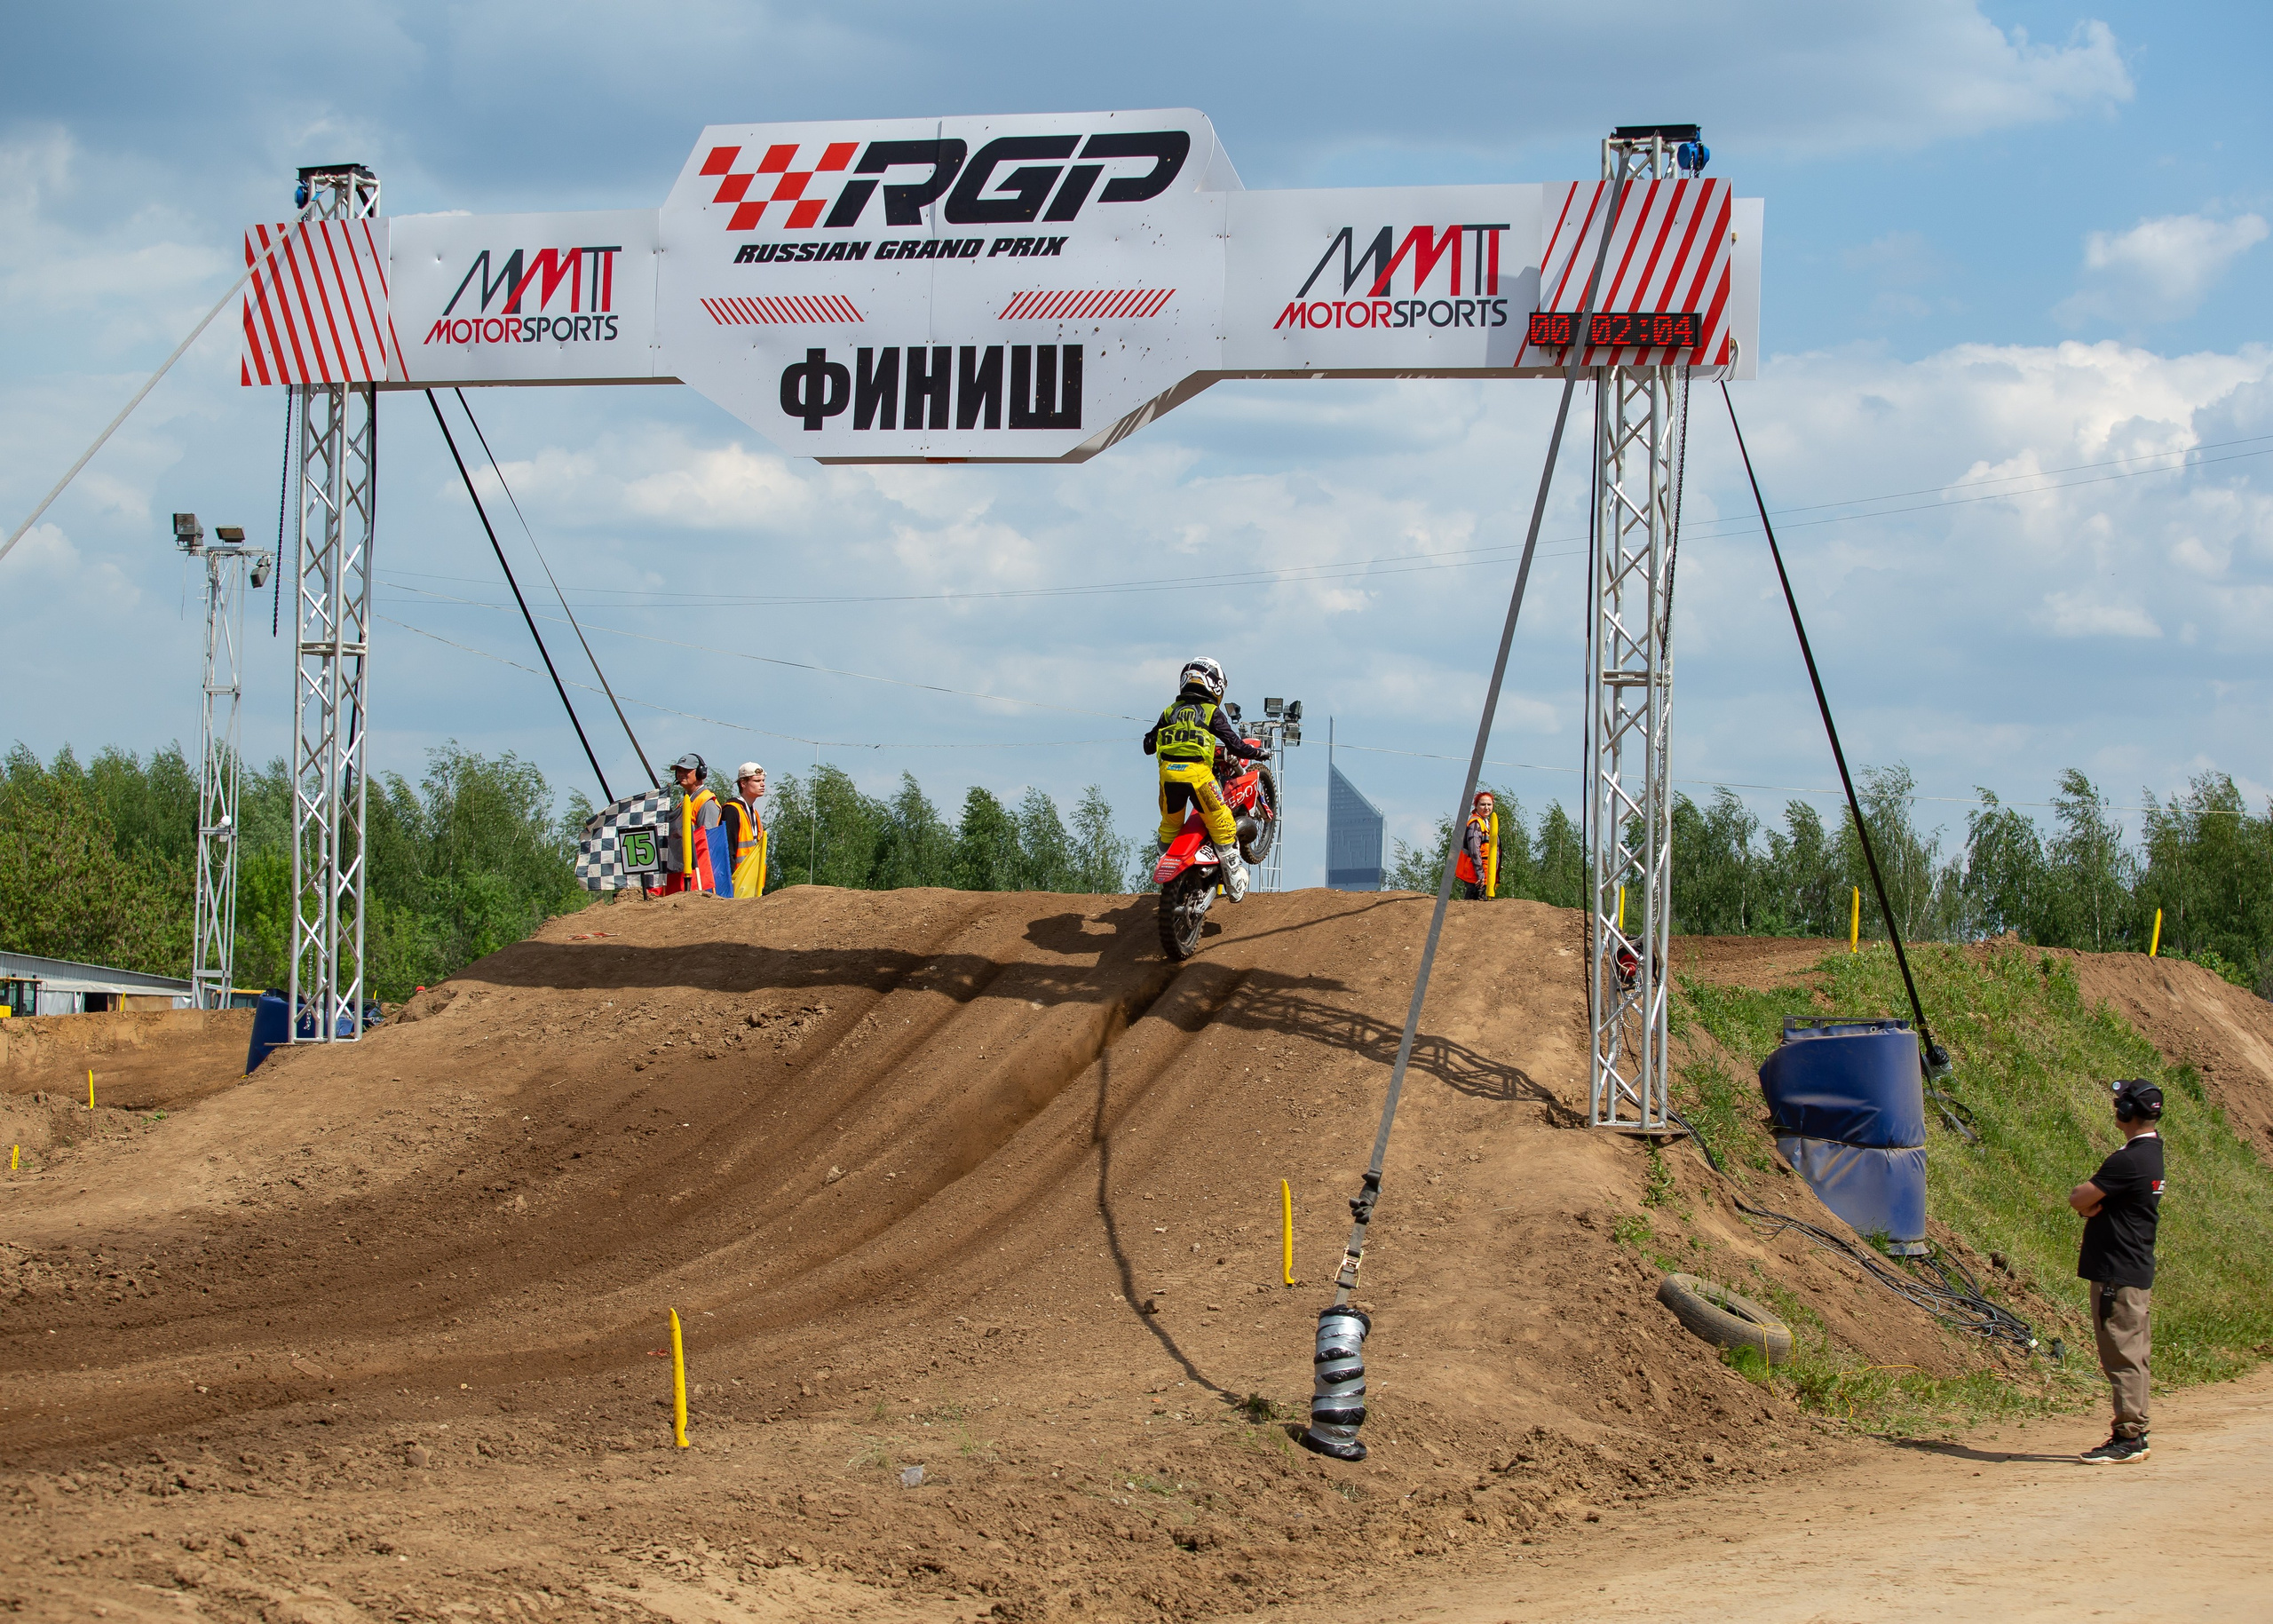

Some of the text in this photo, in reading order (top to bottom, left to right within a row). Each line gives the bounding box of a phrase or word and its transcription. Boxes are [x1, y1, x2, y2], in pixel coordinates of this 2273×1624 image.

[822, 131, 1191, 226] RGP
[733, 236, 1069, 264] RUSSIAN GRAND PRIX
[423, 314, 619, 345] MOTORSPORTS
[1272, 298, 1509, 329] MOTORSPORTS
[780, 344, 1084, 432] ФИНИШ
[623, 833, 656, 867] 15
